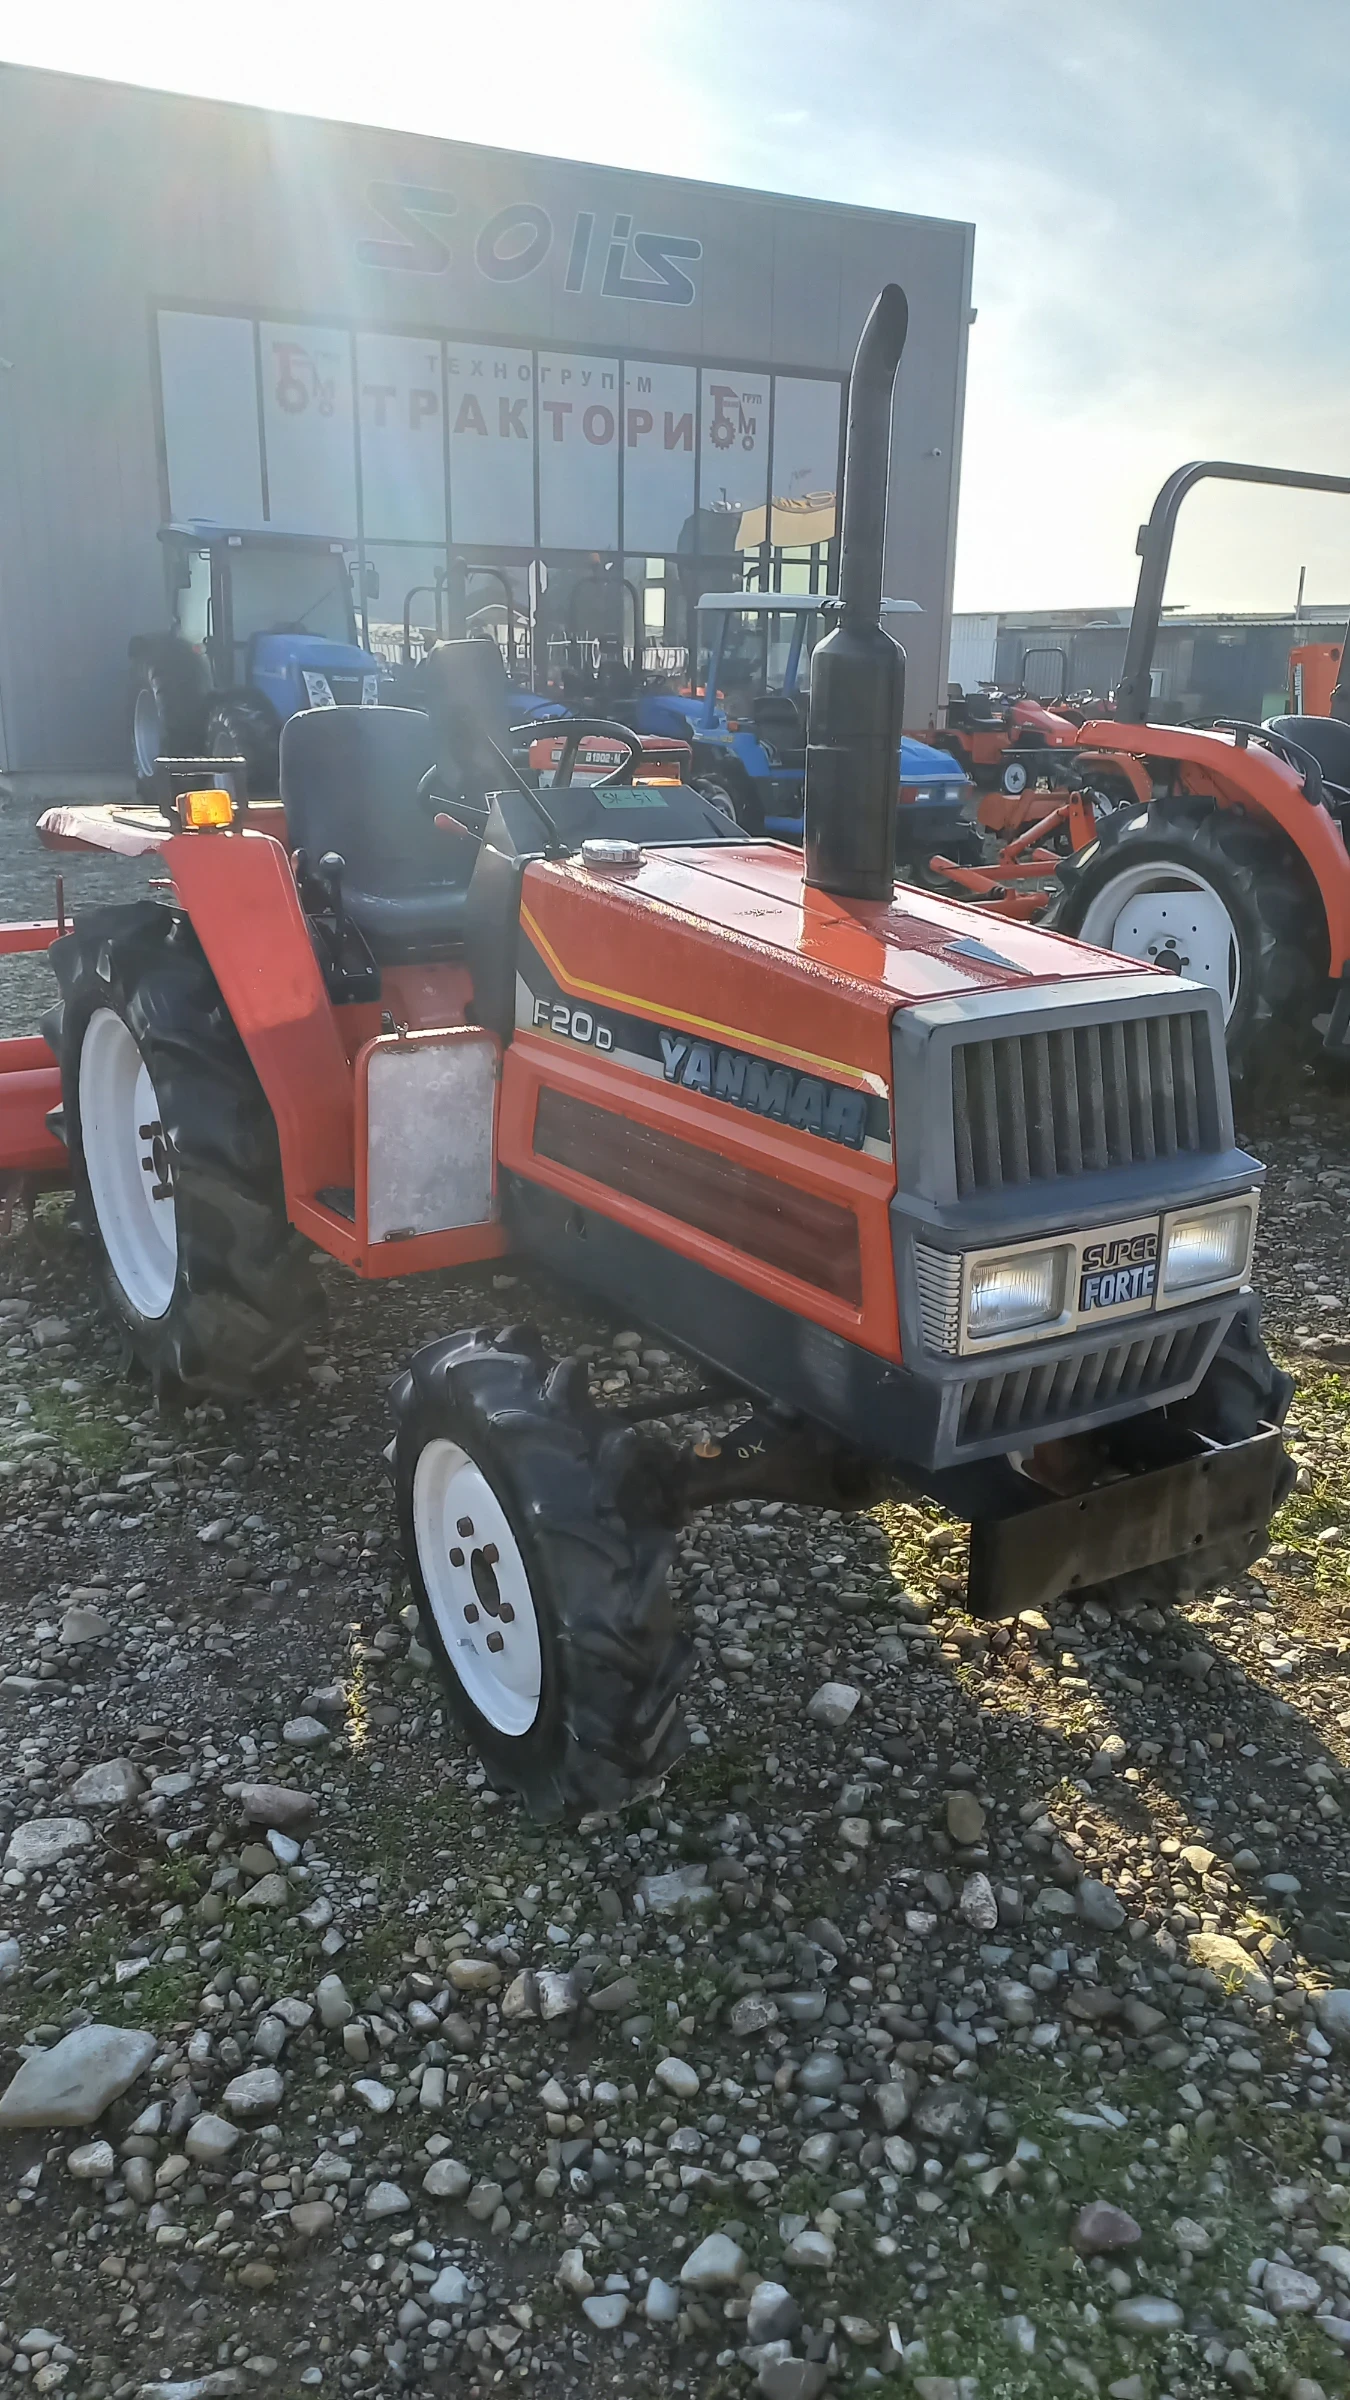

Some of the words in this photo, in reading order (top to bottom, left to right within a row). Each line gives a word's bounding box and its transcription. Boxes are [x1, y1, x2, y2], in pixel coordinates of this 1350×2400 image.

[424, 354, 652, 394] ТЕХНОГРУП-М
[362, 384, 694, 452] ТРАКТОРИ
[658, 1030, 868, 1151] YANMAR
[1082, 1233, 1157, 1272] SUPER
[1081, 1263, 1157, 1311] FORTE
